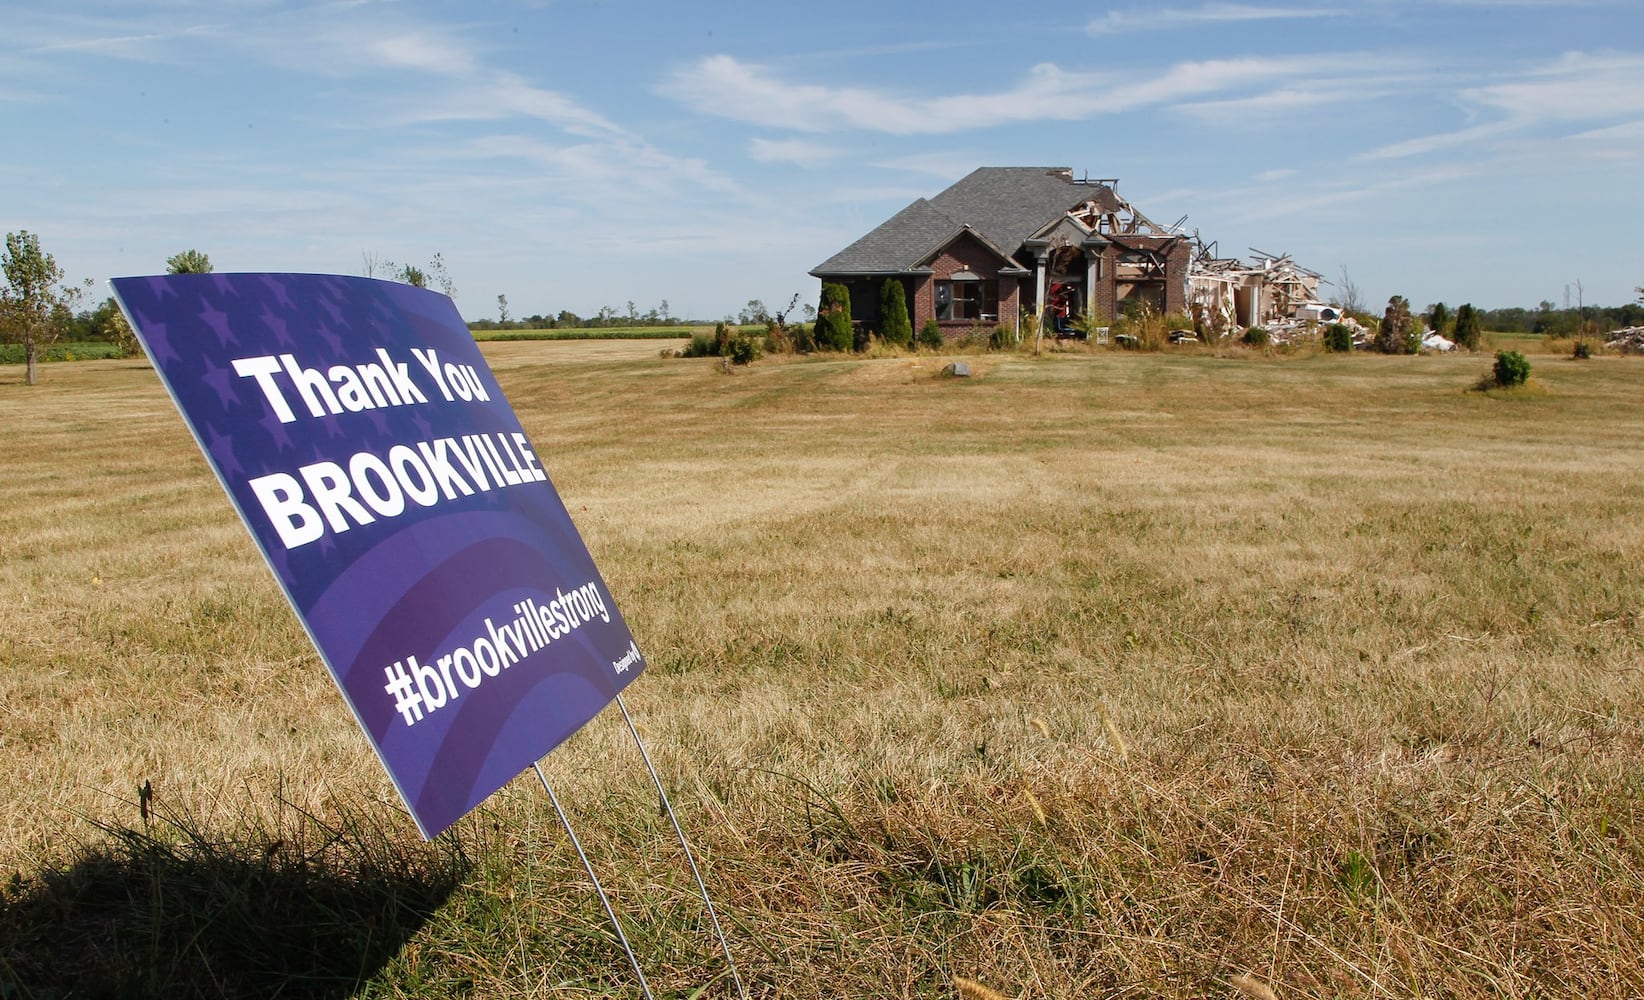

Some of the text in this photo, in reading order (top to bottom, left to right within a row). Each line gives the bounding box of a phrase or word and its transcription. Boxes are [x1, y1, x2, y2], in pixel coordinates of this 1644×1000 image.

[231, 347, 491, 424] Thank You
[248, 432, 548, 550] BROOKVILLE
[384, 581, 610, 726] #brookvillestrong
